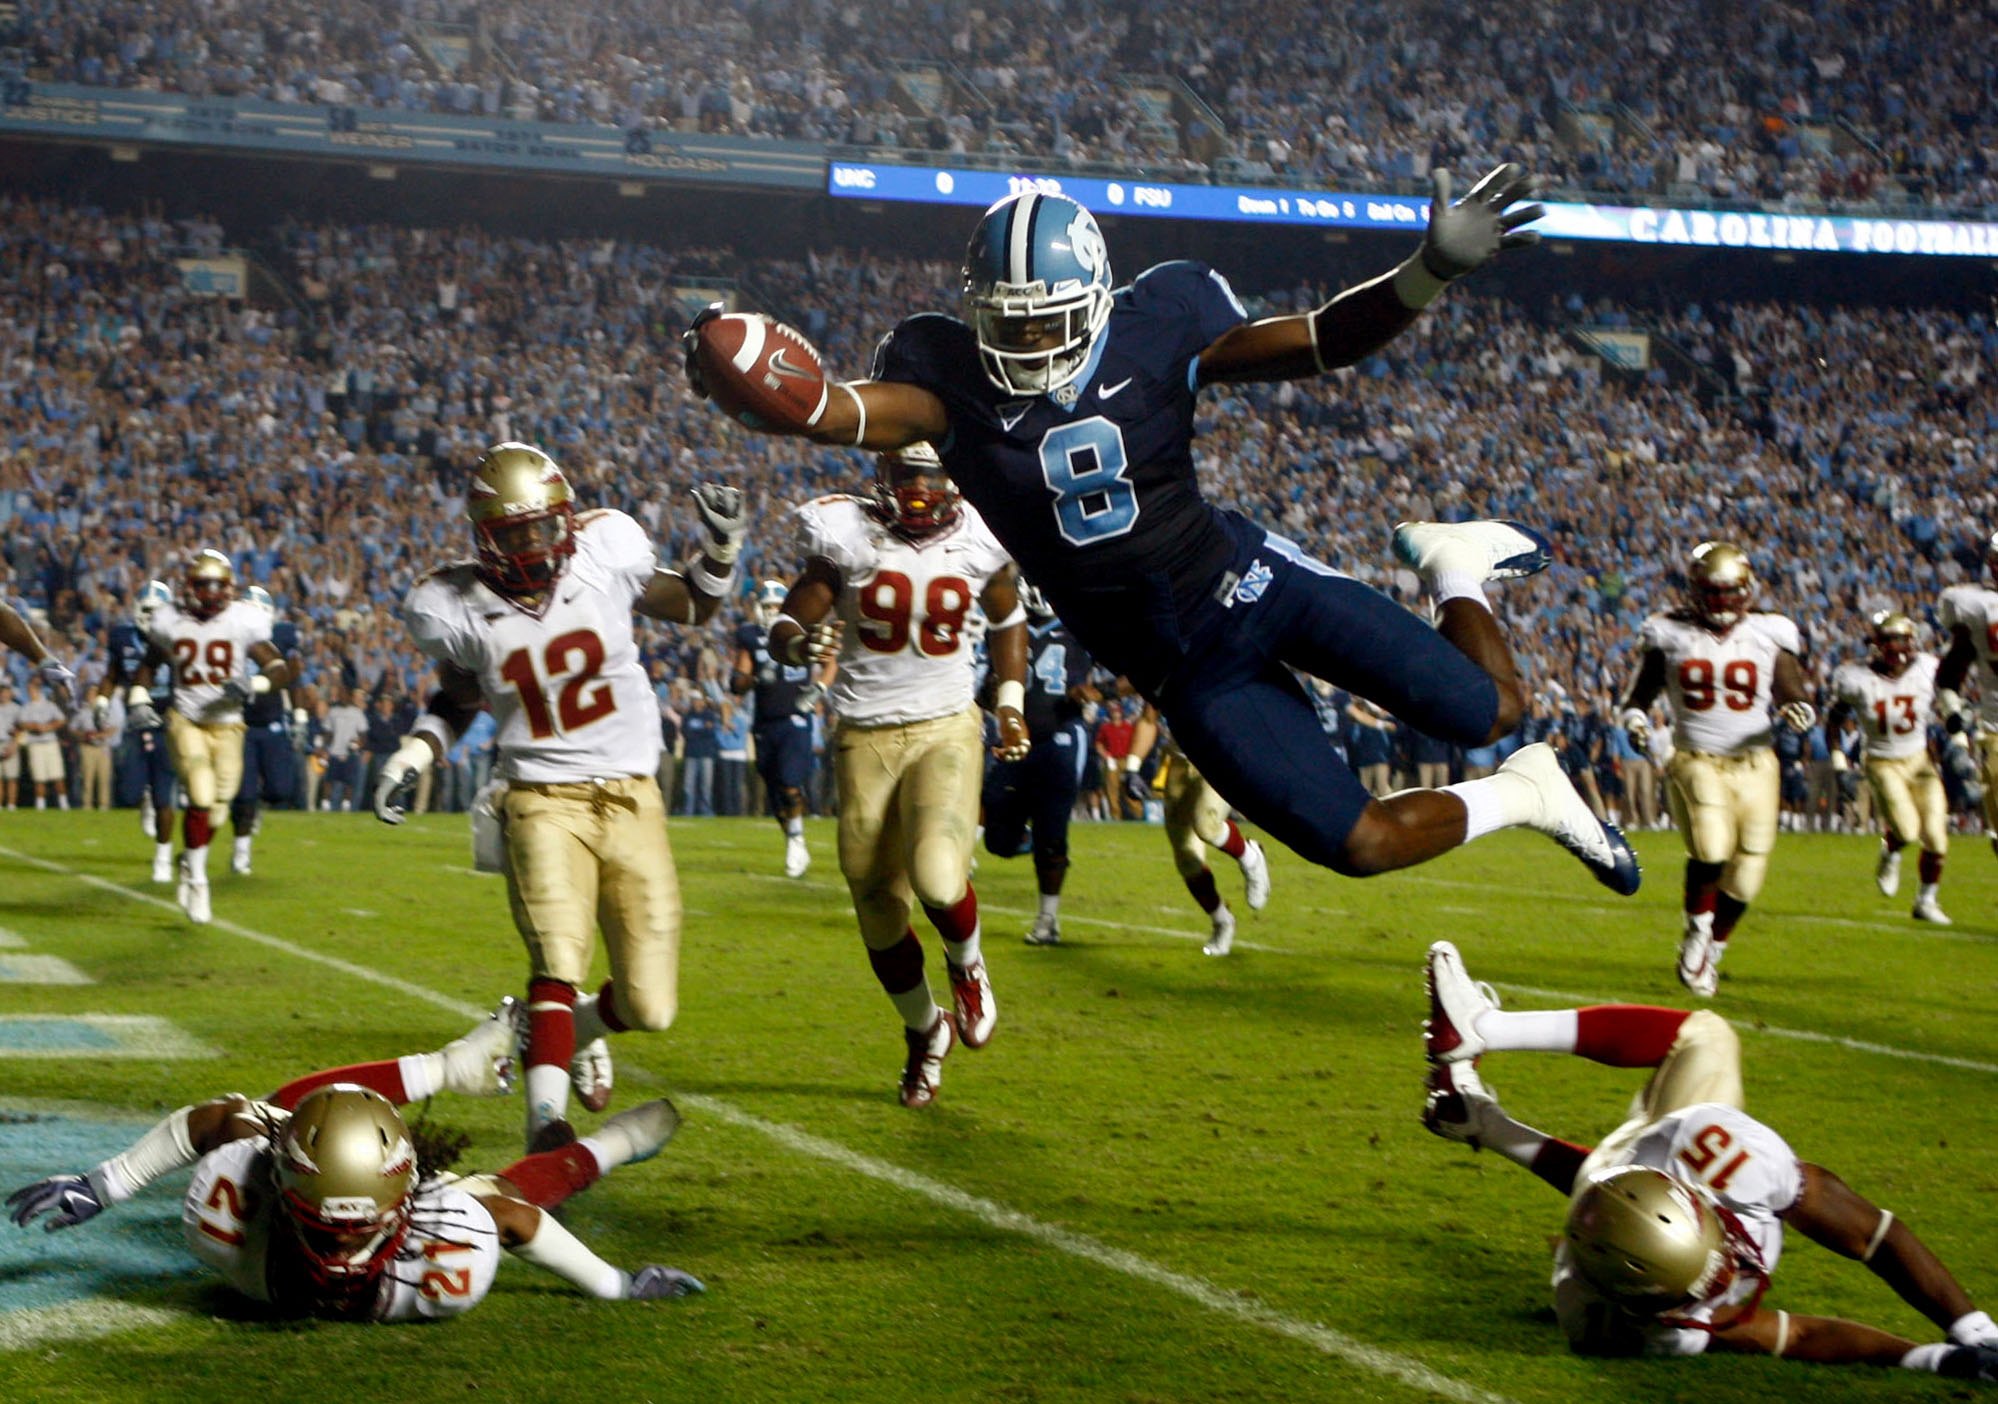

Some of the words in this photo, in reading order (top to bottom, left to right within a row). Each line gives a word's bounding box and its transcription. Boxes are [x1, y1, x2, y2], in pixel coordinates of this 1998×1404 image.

[833, 167, 876, 189] UNC
[936, 171, 954, 194] 0
[1107, 182, 1125, 205] 0
[1133, 186, 1172, 208] FSU
[1629, 206, 1840, 251] CAROLINA
[1038, 415, 1140, 547] 8
[857, 570, 972, 656] 98
[174, 638, 235, 687] 29
[500, 628, 618, 740] 12
[1679, 660, 1758, 711] 99
[1873, 695, 1917, 735] 13
[1680, 1123, 1750, 1191] 15
[200, 1175, 247, 1247] 21
[422, 1240, 472, 1300] 21
